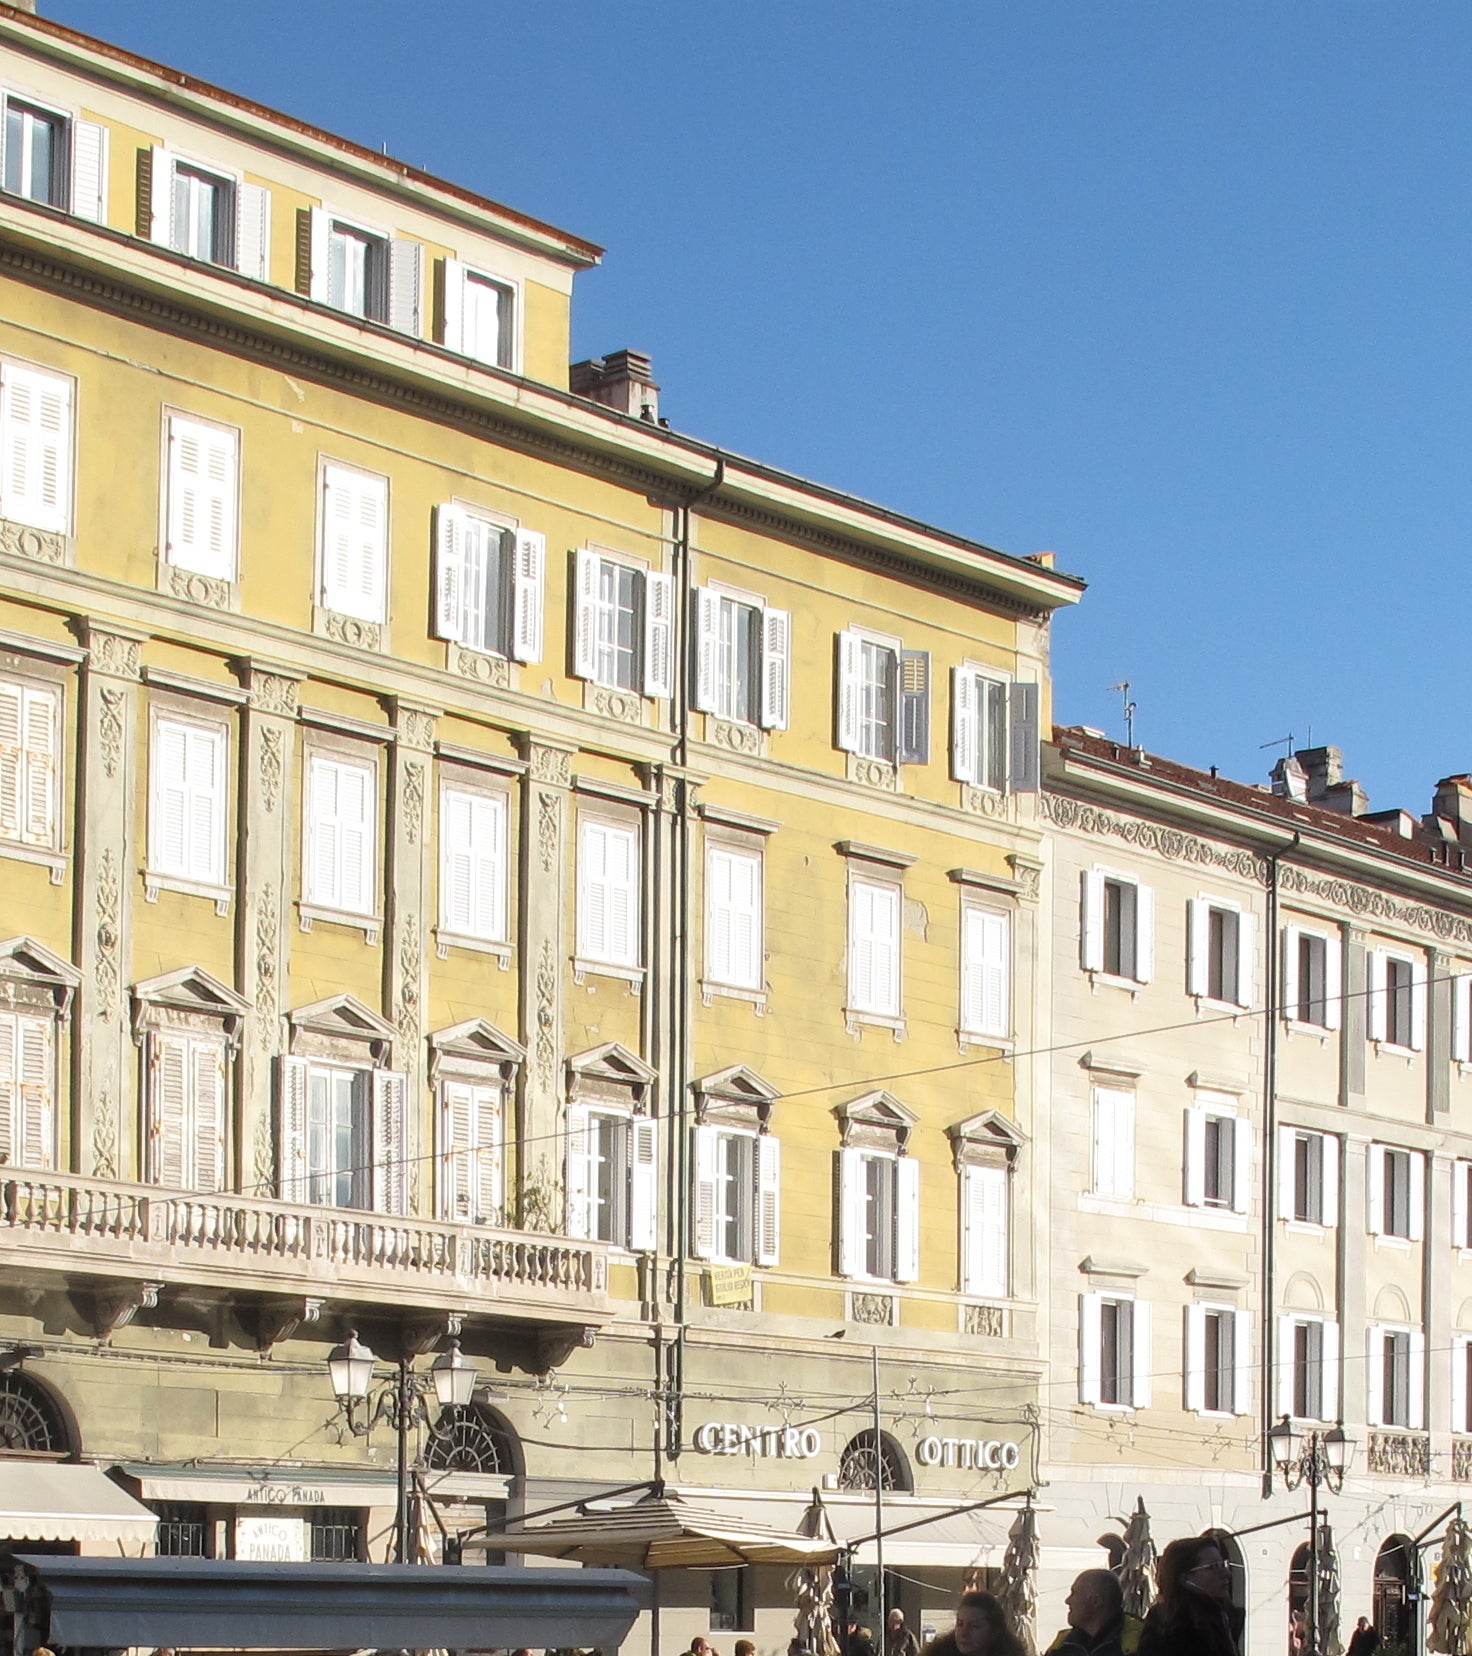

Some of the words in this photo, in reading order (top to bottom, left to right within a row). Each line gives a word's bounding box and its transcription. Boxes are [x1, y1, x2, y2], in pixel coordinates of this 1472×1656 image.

[700, 1422, 821, 1458] CENTRO
[921, 1436, 1019, 1469] OTTICO
[247, 1487, 287, 1503] ANTICO
[292, 1487, 326, 1503] PANADA
[252, 1522, 288, 1542] ANTICO
[249, 1543, 291, 1561] PANADA
